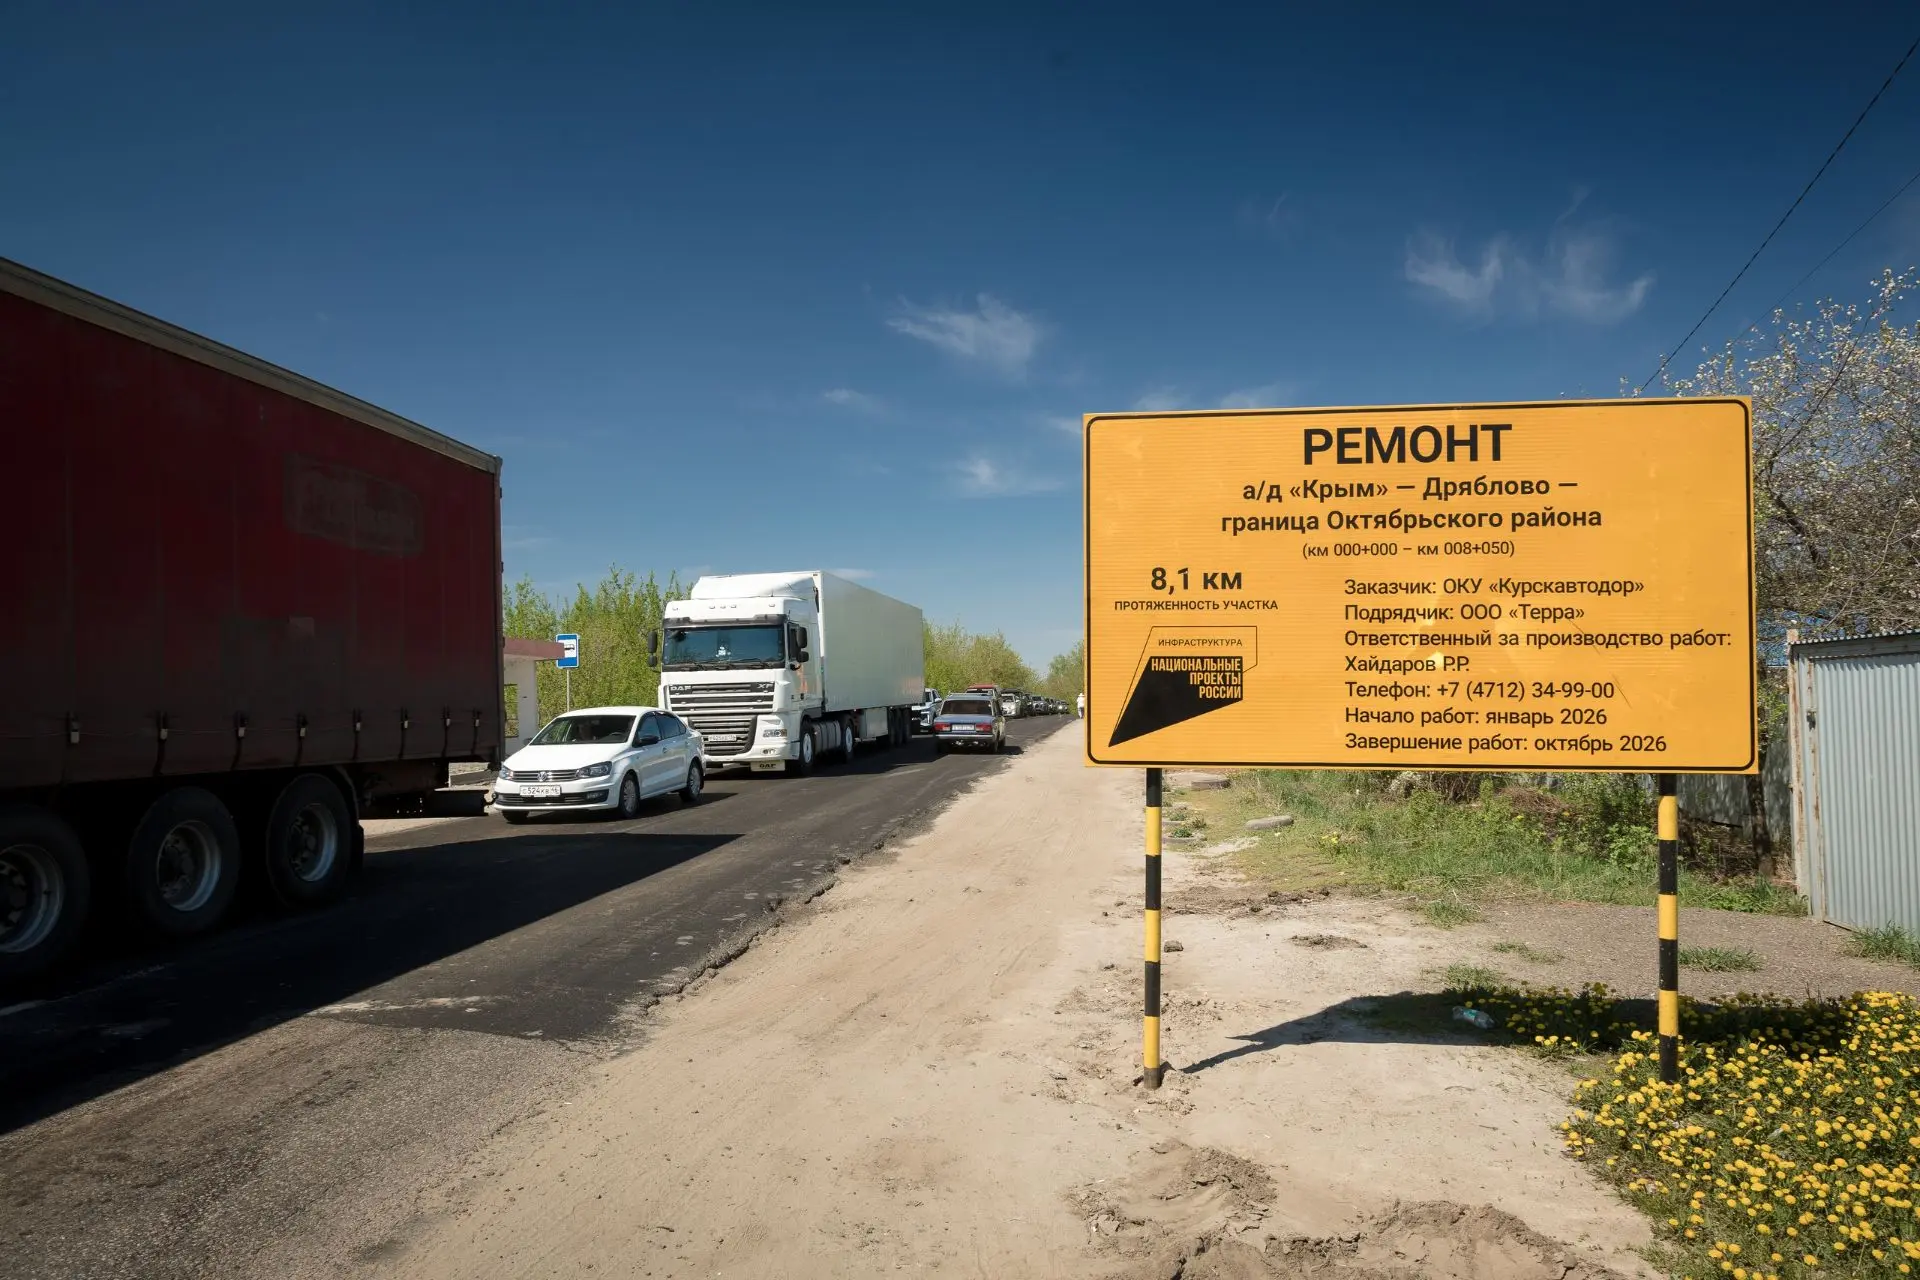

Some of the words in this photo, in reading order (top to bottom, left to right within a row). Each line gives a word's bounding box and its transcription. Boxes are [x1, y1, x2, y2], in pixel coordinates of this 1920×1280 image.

[1303, 423, 1513, 466] РЕМОНТ
[1242, 480, 1283, 504] а/д
[1289, 479, 1388, 504] «Крым»
[1422, 474, 1551, 502] Дряблово
[1221, 515, 1320, 537] граница
[1326, 507, 1504, 534] Октябрьского
[1511, 506, 1602, 533] района
[1302, 543, 1329, 560] (км
[1333, 542, 1398, 557] 000+000
[1417, 545, 1439, 556] км
[1443, 540, 1515, 558] 008+050)
[1150, 566, 1189, 596] 8,1
[1202, 571, 1243, 590] км
[1344, 578, 1437, 595] Заказчик:
[1443, 577, 1483, 595] ОКУ
[1488, 577, 1645, 598] «Курскавтодор»
[1114, 600, 1220, 611] ПРОТЯЖЕННОСТЬ
[1222, 599, 1279, 610] УЧАСТКА
[1344, 604, 1454, 625] Подрядчик:
[1460, 603, 1502, 620] ООО
[1509, 603, 1585, 624] «Терра»
[1158, 638, 1243, 647] ИНФРАСТРУКТУРА
[1344, 629, 1492, 647] Ответственный
[1498, 633, 1520, 646] за
[1526, 633, 1664, 650] производство
[1670, 628, 1732, 650] работ:
[1150, 658, 1242, 674] НАЦИОНАЛЬНЫЕ
[1344, 655, 1437, 676] Хайдаров
[1443, 655, 1470, 672] Р.Р.
[1189, 671, 1242, 686] ПРОЕКТЫ
[1198, 685, 1242, 700] РОССИИ
[1344, 680, 1431, 702] Телефон:
[1436, 681, 1460, 698] +7
[1466, 680, 1525, 703] (4712)
[1531, 681, 1615, 699] 34-99-00
[1345, 706, 1415, 724] Начало
[1420, 706, 1479, 728] работ:
[1485, 711, 1554, 729] январь
[1560, 708, 1608, 725] 2026
[1345, 732, 1463, 754] Завершение
[1468, 733, 1528, 755] работ:
[1534, 733, 1614, 756] октябрь
[1619, 735, 1667, 752] 2026
